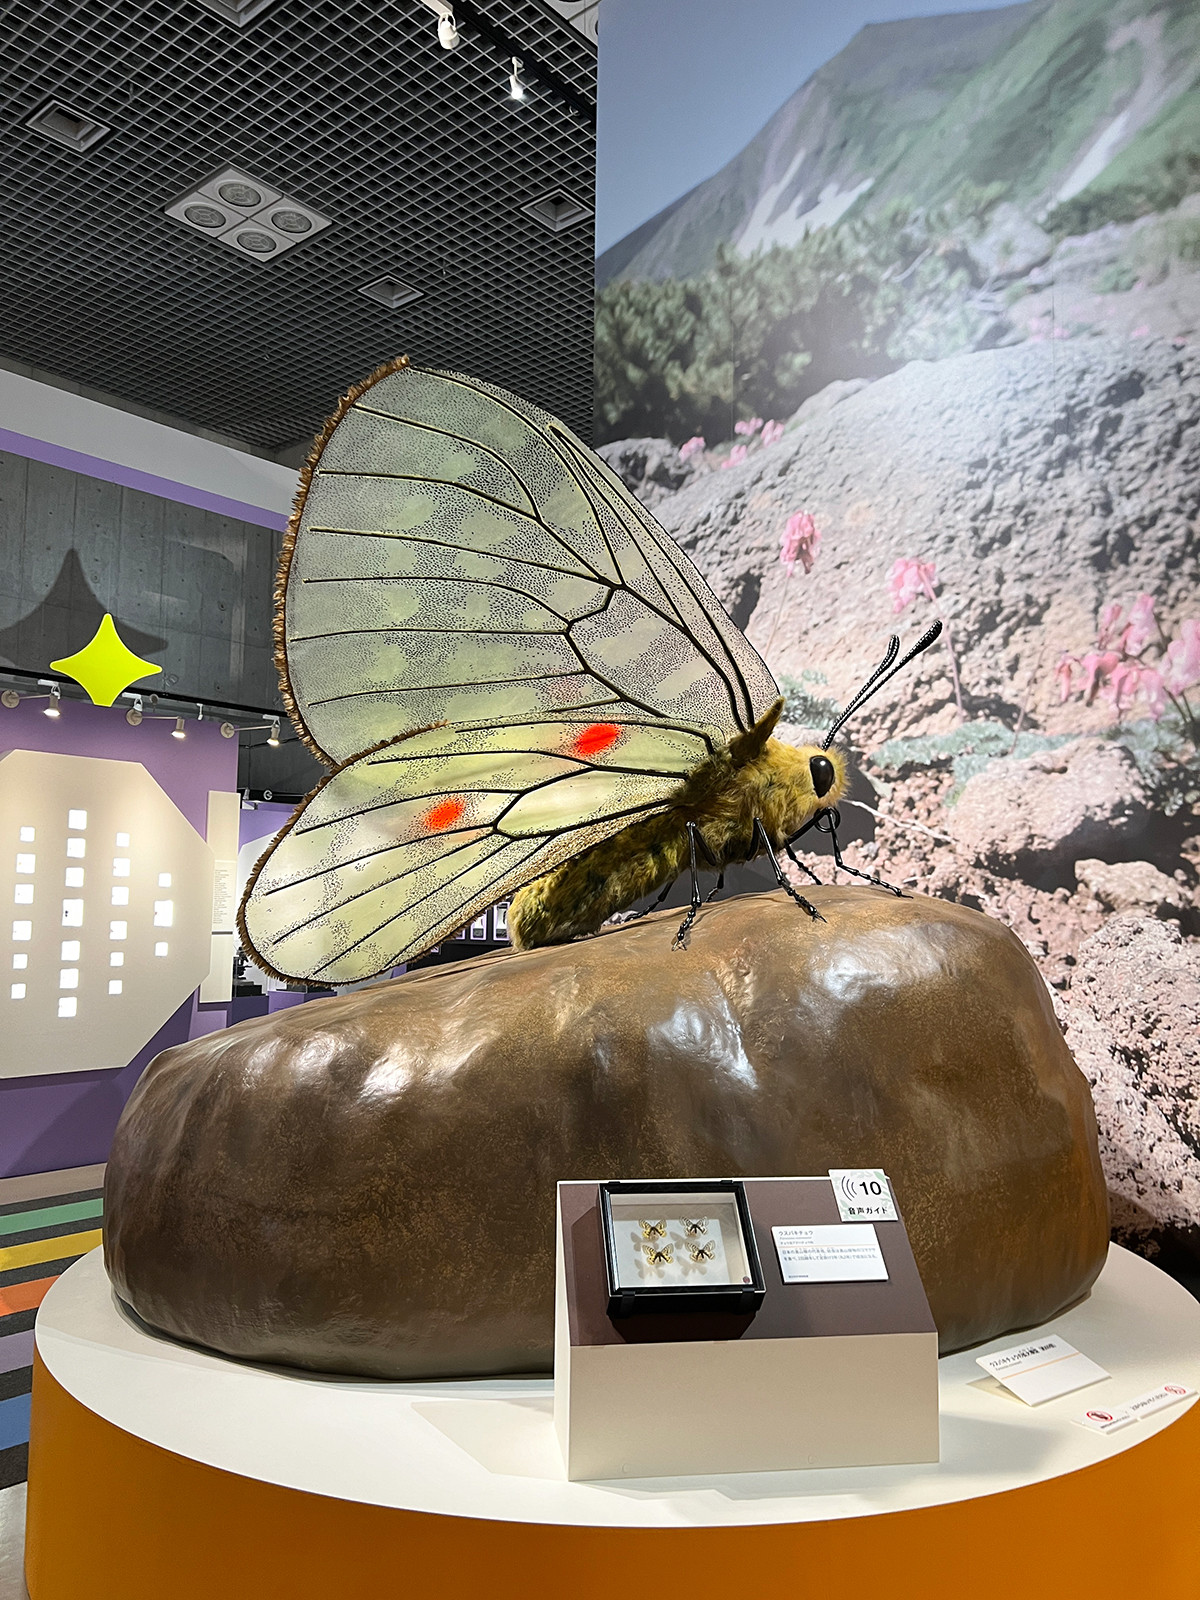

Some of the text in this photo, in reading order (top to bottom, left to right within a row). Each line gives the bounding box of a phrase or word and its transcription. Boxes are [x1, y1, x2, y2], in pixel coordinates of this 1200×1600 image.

[859, 1181, 882, 1195] 10
[848, 1207, 888, 1215] 音声ガイド
